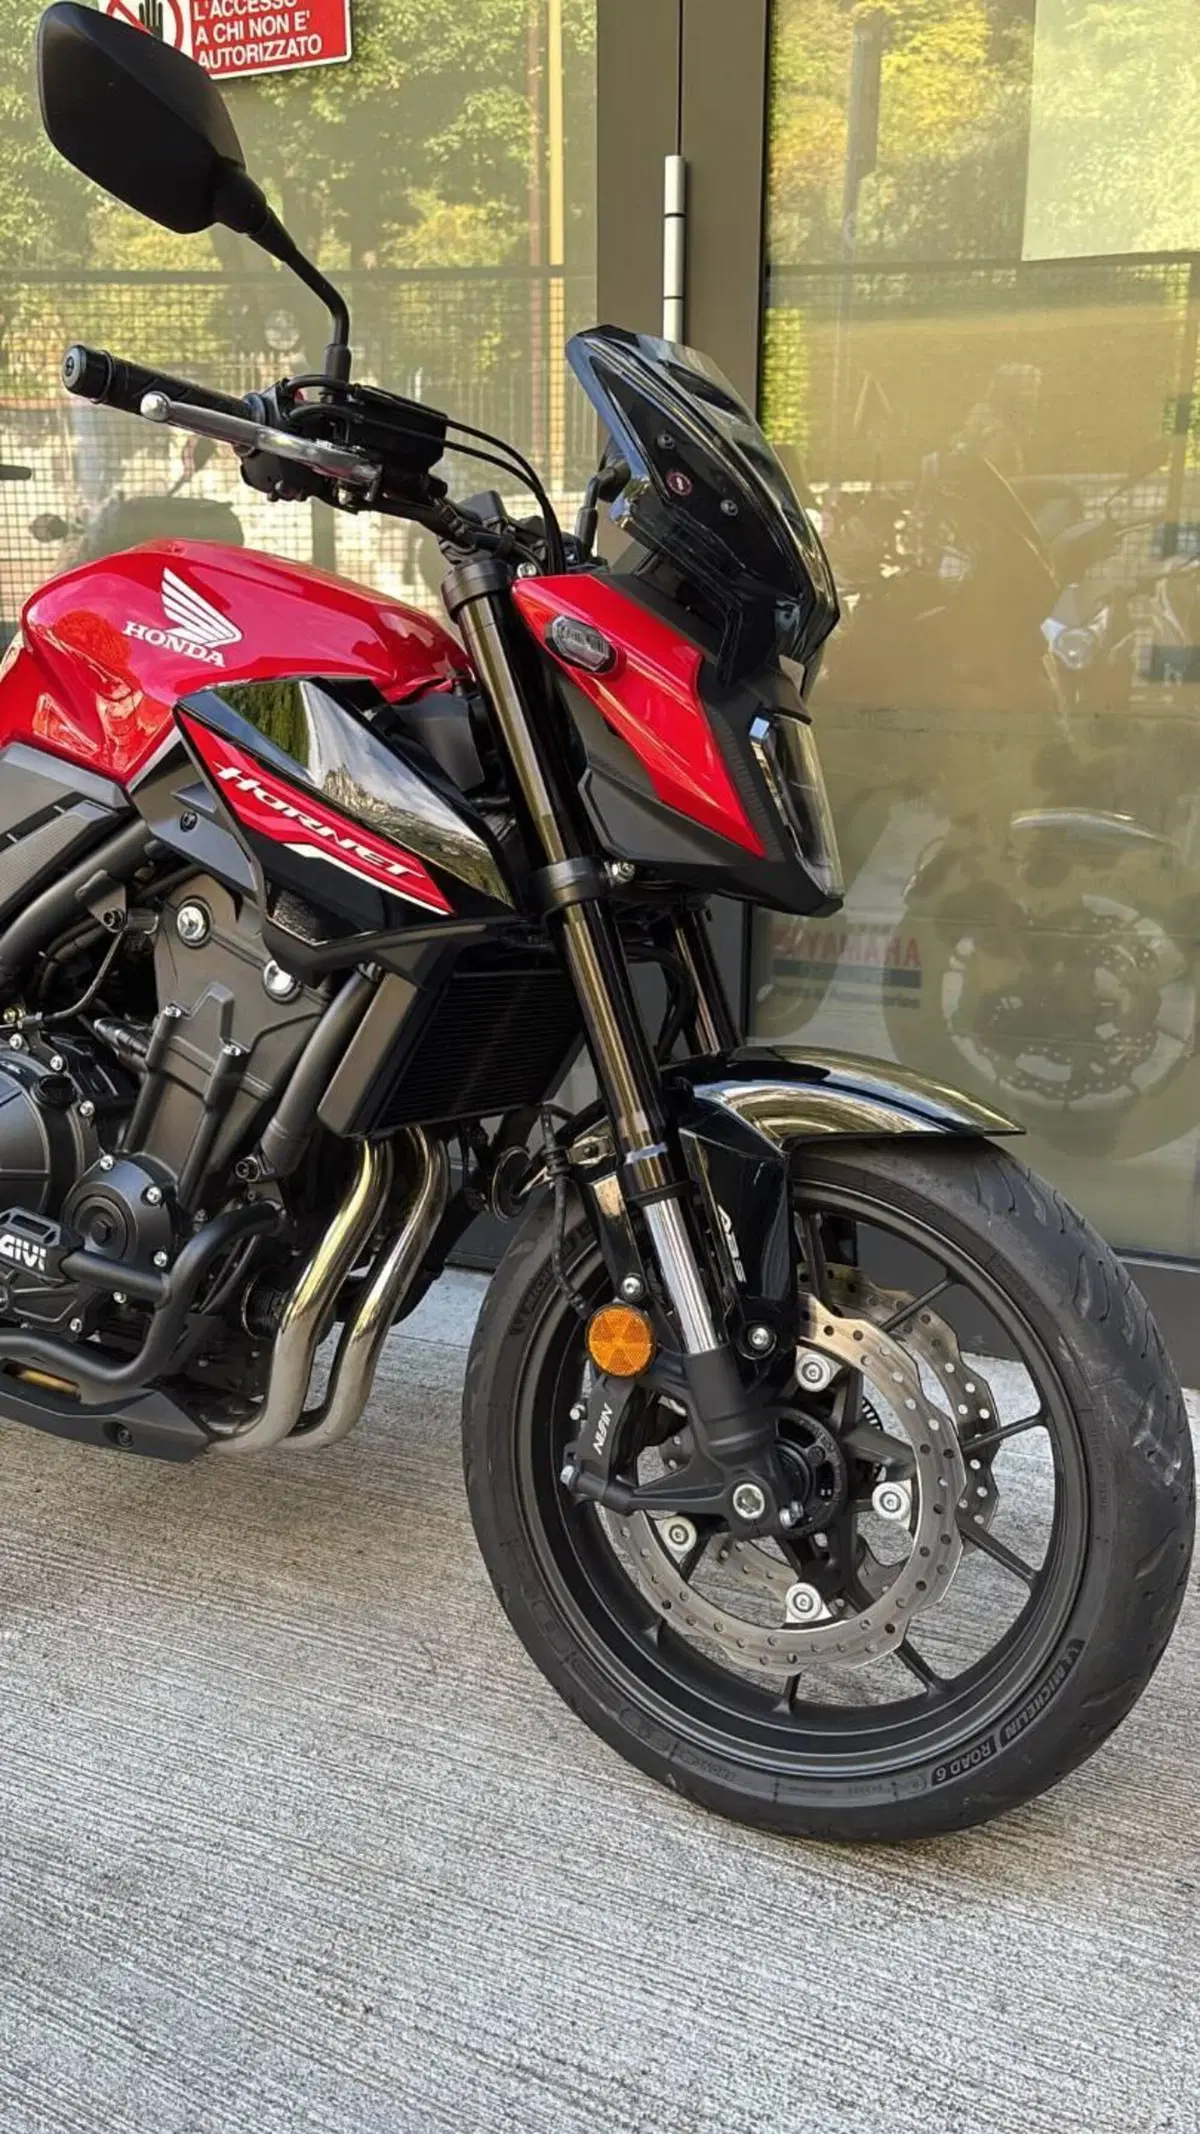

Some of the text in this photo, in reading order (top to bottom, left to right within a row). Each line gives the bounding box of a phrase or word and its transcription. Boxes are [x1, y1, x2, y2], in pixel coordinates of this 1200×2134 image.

[195, 10, 310, 45] A CHI NON E'
[198, 34, 322, 69] AUTORIZZATO
[121, 620, 226, 668] HONDA
[212, 761, 424, 878] HORNET
[0, 1233, 47, 1272] GIVI
[1004, 1658, 1066, 1741] MICHELIN
[935, 1742, 992, 1782] ROAD 6
